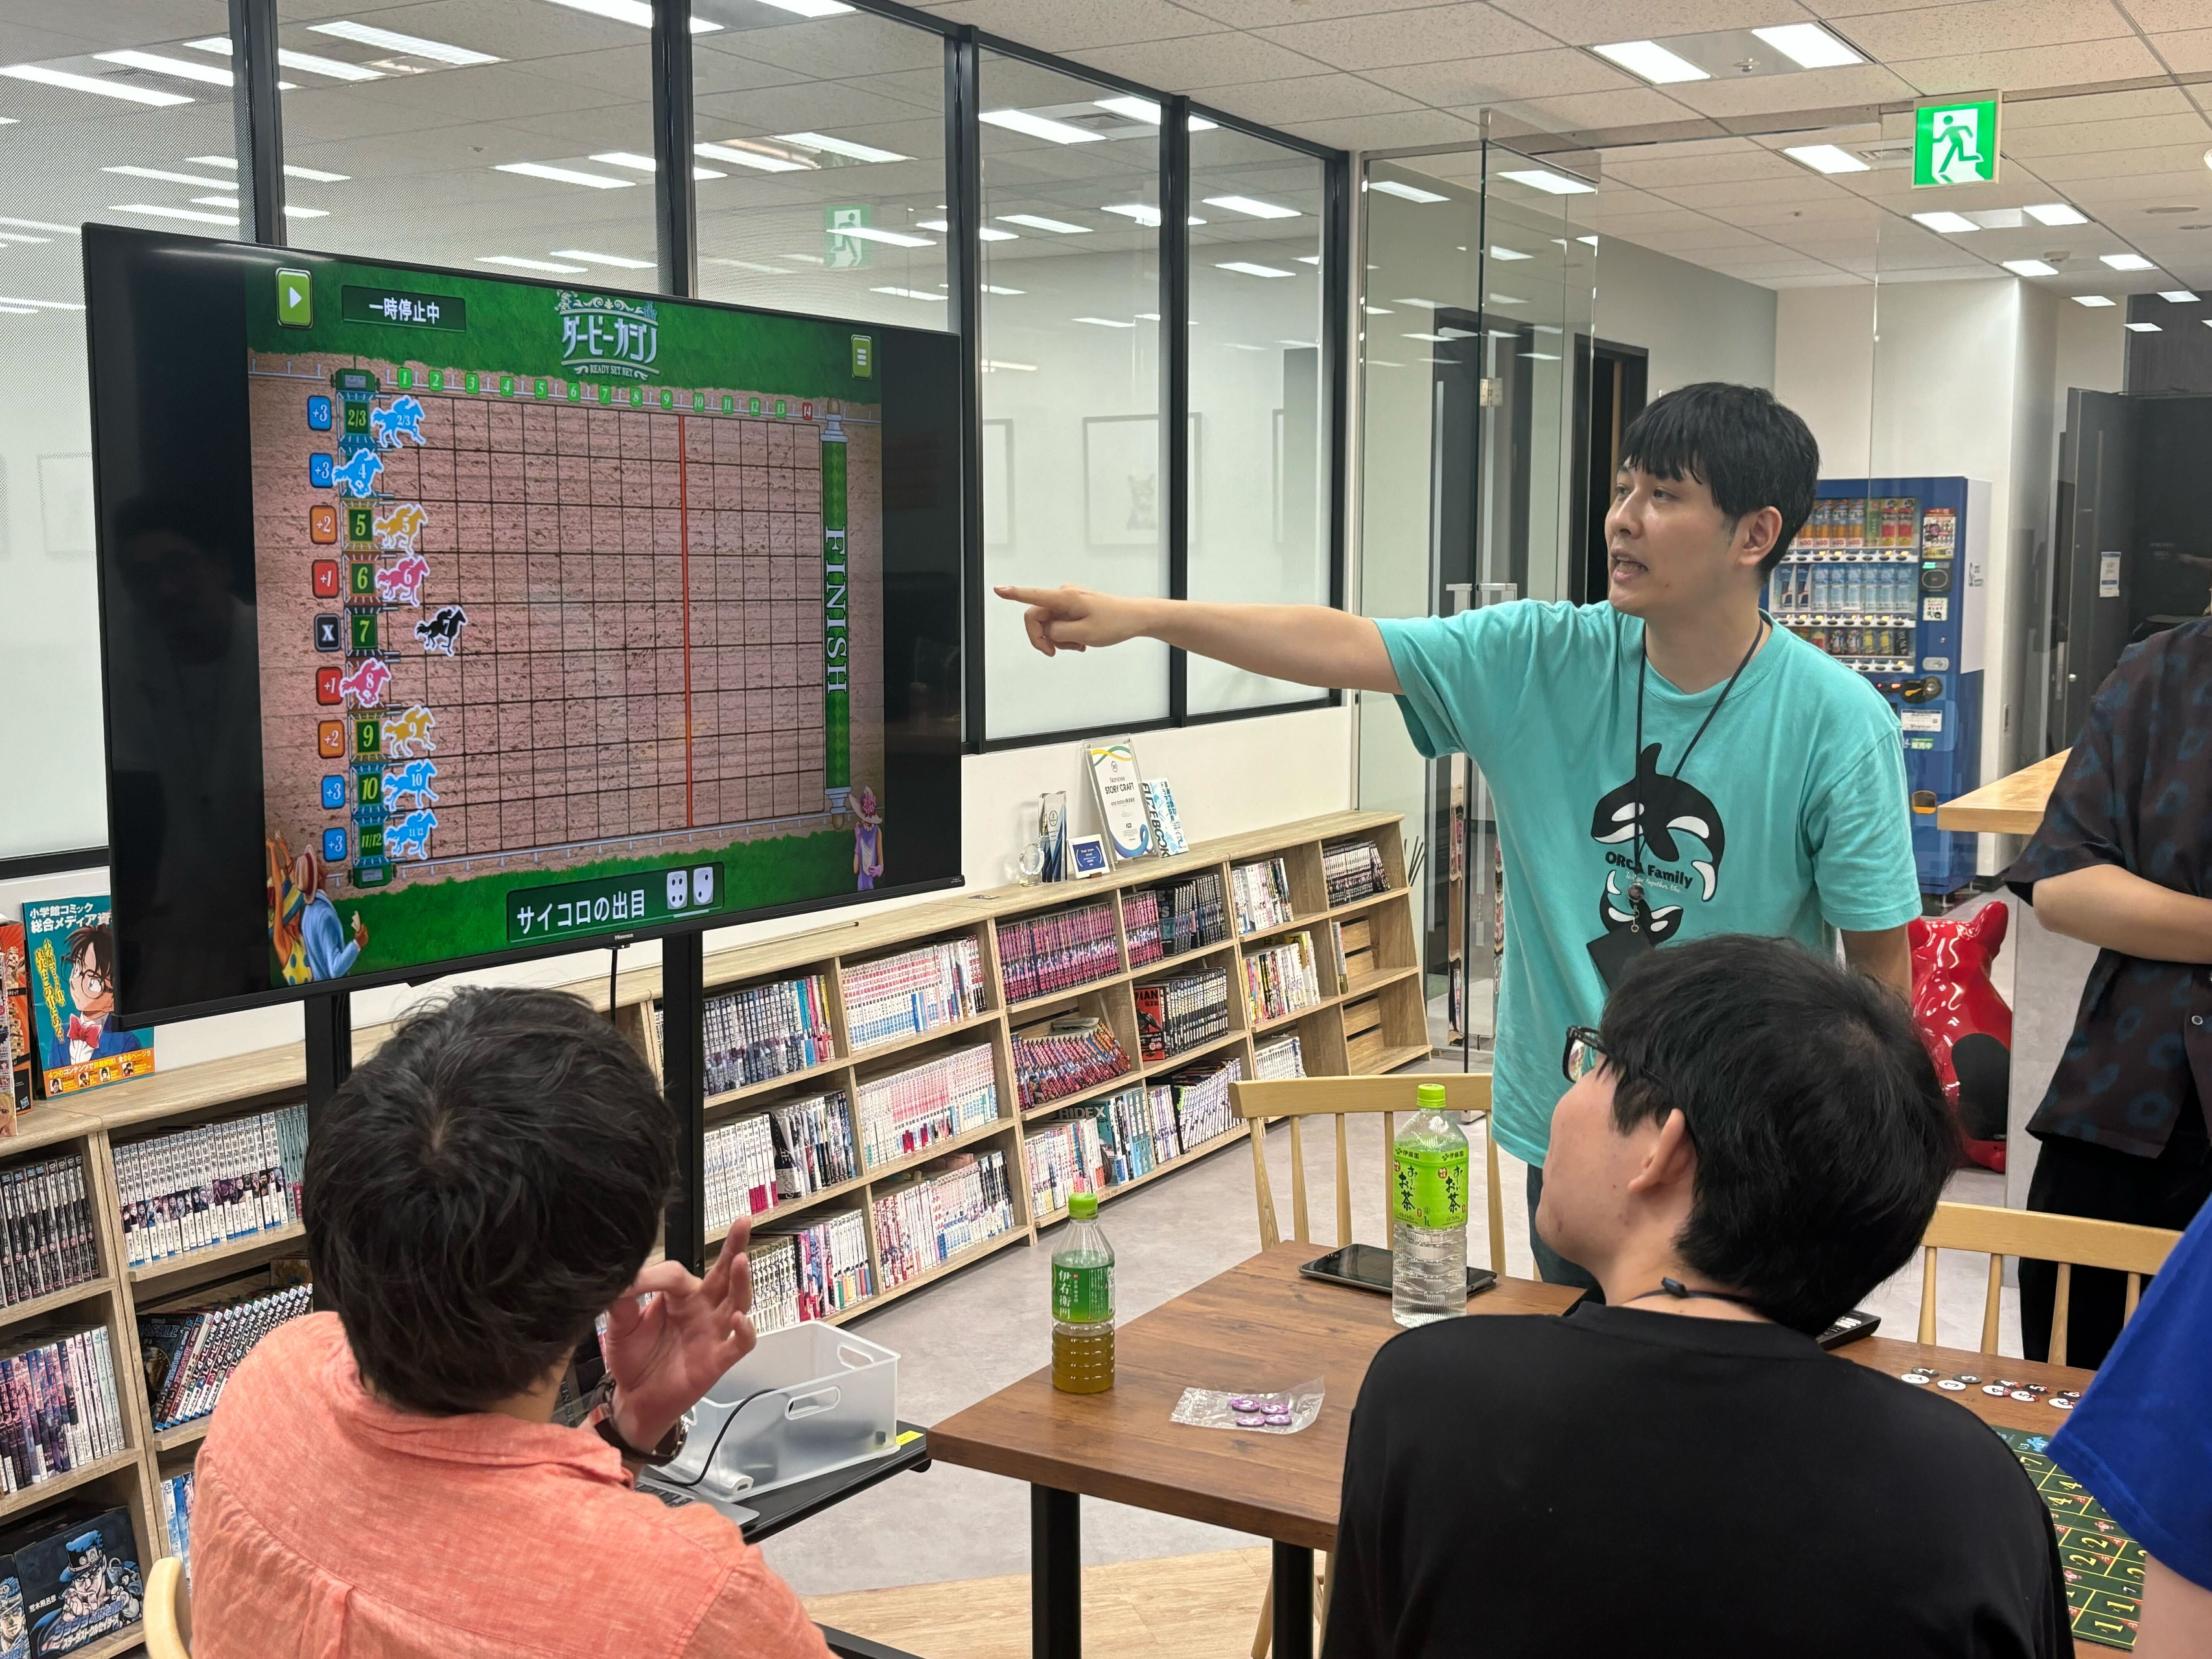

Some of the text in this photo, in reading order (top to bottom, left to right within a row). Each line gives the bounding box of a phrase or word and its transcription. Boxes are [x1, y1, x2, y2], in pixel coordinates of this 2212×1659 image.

[369, 296, 440, 324] 一時停止中
[562, 315, 657, 364] ダービーカジノ
[590, 364, 633, 377] READY SET BET
[403, 371, 812, 417] 1 2 3 4 5 6 7 8 9 10 11 12 13 14
[313, 405, 328, 422] +3
[347, 410, 366, 427] 2/3
[397, 414, 411, 426] 2/3
[315, 462, 330, 478] +3
[358, 463, 367, 479] 4
[316, 515, 331, 533] +2
[355, 514, 366, 536] 5
[402, 517, 410, 533] 5
[320, 570, 332, 587] +1
[357, 566, 368, 590] 6
[404, 569, 412, 585] 6
[825, 526, 848, 694] FINISH
[321, 624, 335, 642] X
[359, 620, 370, 643] 7
[443, 619, 451, 635] 7
[323, 677, 336, 694] +1
[366, 672, 375, 689] 8
[363, 725, 374, 747] 9
[409, 722, 417, 734] 9
[325, 730, 339, 747] +2
[412, 773, 422, 786] 10
[326, 783, 341, 800] +3
[362, 778, 378, 800] 10
[1105, 782, 1134, 795] STORY CRAFT
[328, 835, 343, 853] +3
[361, 833, 382, 849] 11/12
[1647, 864, 1694, 889] Family
[30, 902, 93, 919] 小学館コミック
[516, 888, 646, 934] サイコロの出目
[30, 912, 113, 933] 総合メディア資
[1059, 1106, 1106, 1119] RIDEX
[1399, 1172, 1415, 1211] お茶
[1446, 1176, 1460, 1213] お茶
[1058, 1270, 1071, 1319] 伊右衛門
